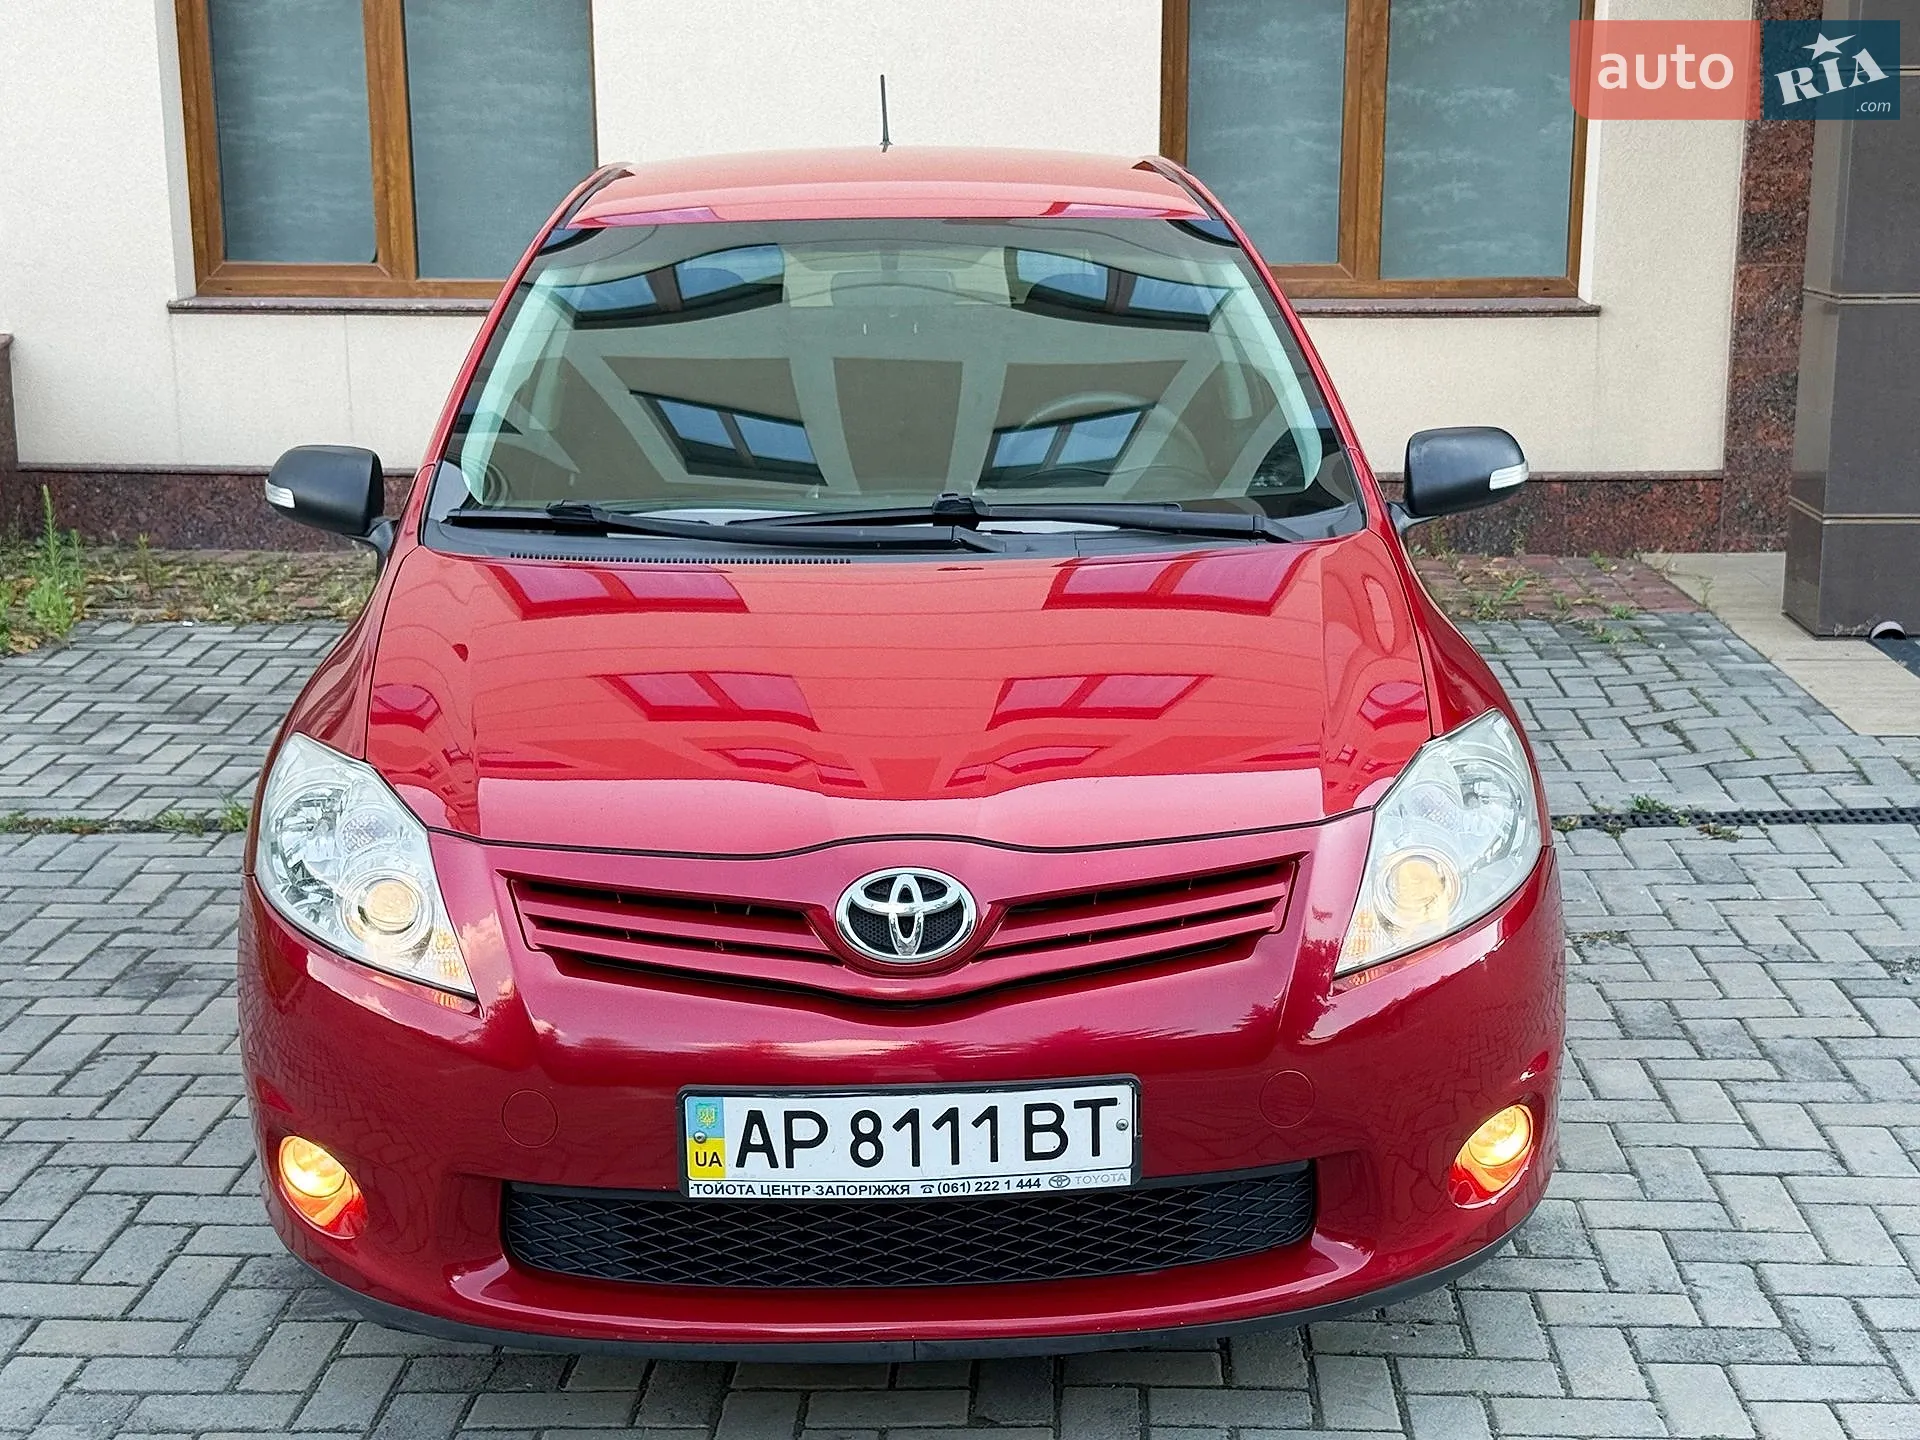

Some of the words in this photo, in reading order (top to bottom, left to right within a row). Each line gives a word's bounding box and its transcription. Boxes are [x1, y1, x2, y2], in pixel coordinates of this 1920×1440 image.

[735, 1109, 828, 1169] AP
[849, 1105, 998, 1168] 8111
[1023, 1097, 1119, 1162] BT
[694, 1151, 723, 1168] UA
[693, 1182, 756, 1196] ТОЙОТА
[760, 1184, 811, 1198] ЦЕНТР
[815, 1184, 910, 1196] ЗАПОРІЖЖЯ
[938, 1181, 971, 1195] (061)
[975, 1179, 1000, 1192] 222
[1004, 1179, 1011, 1191] 1
[1016, 1178, 1041, 1190] 444
[1075, 1173, 1127, 1185] TOYOTA
